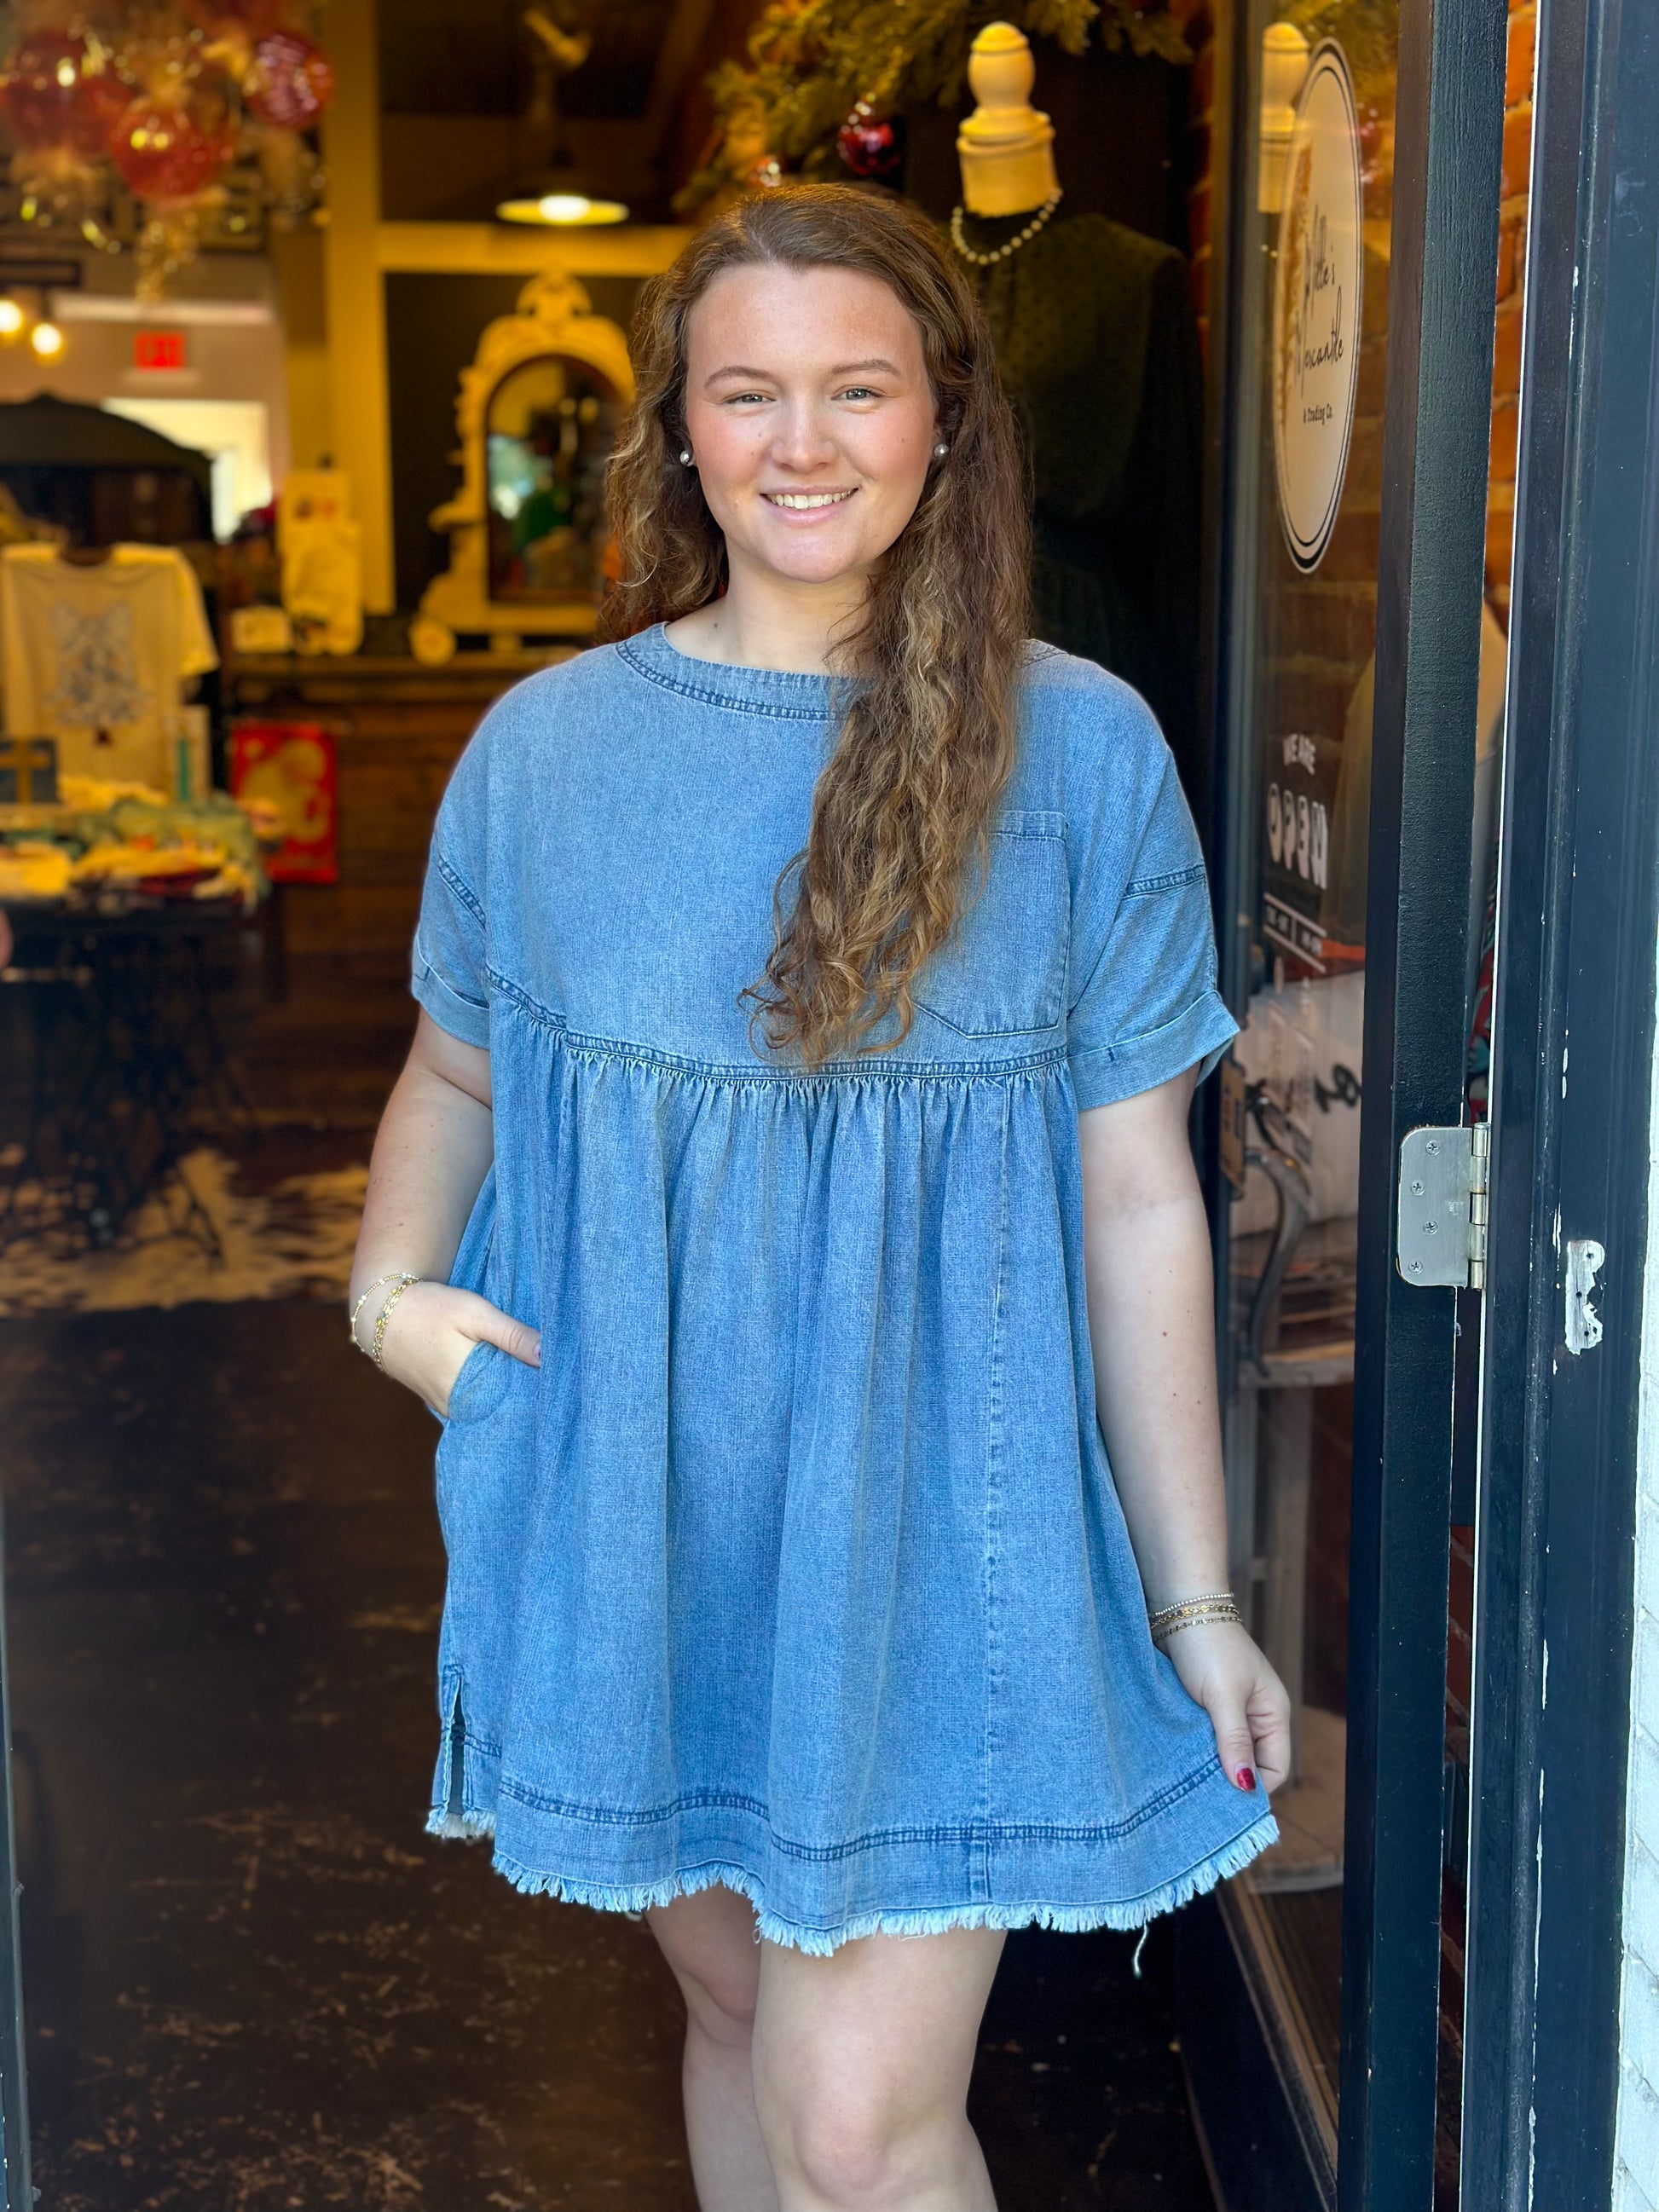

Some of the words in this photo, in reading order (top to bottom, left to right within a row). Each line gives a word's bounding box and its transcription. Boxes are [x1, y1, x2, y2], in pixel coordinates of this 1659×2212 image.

[1308, 405, 1326, 424] Trading
[1282, 733, 1298, 766] WE
[1298, 735, 1316, 775] ARE
[1266, 782, 1328, 889] OPEN
